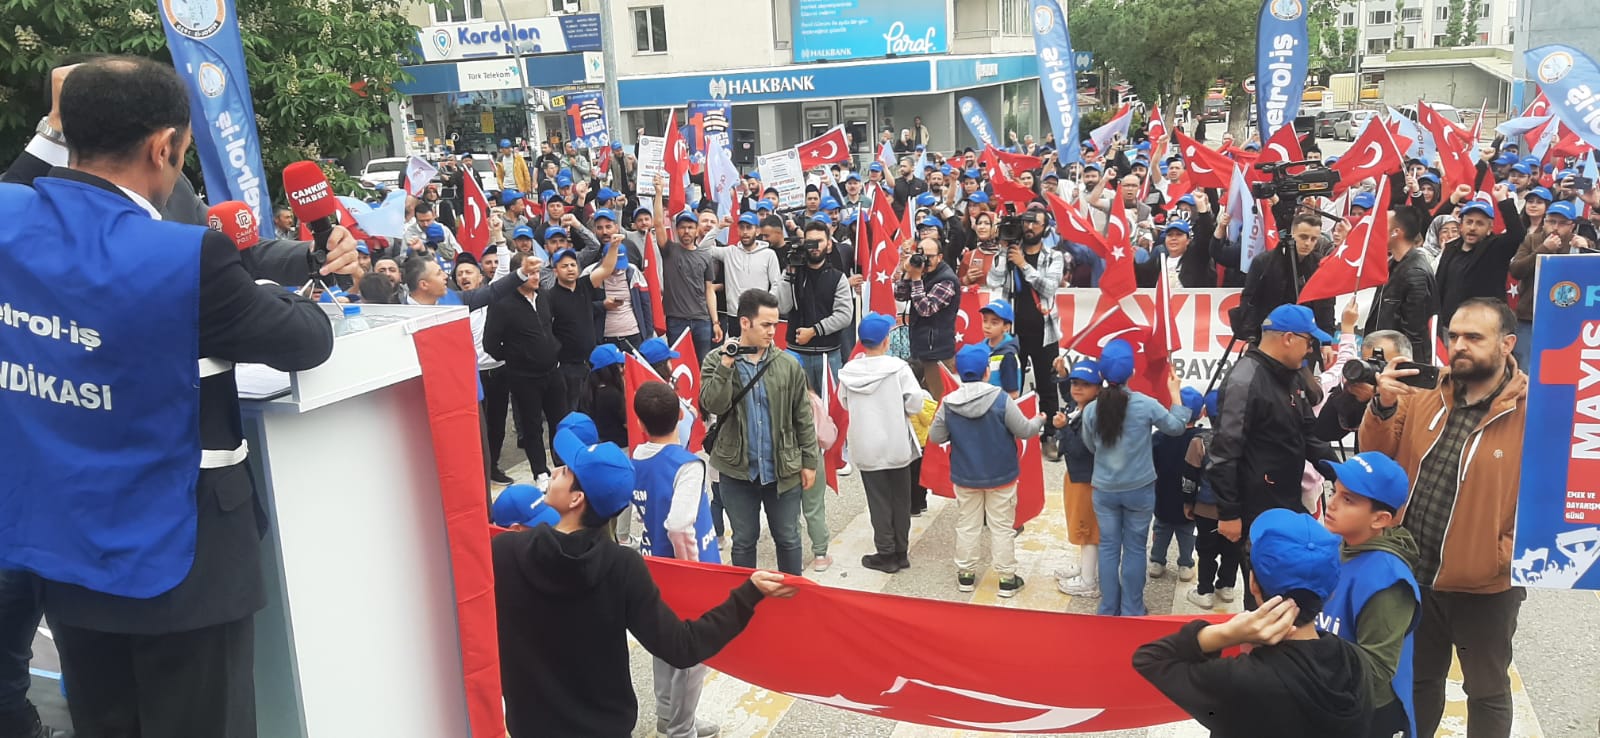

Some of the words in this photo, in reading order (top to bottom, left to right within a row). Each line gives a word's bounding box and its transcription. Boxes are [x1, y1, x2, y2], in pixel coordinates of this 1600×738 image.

[810, 47, 852, 57] HALKBANK
[483, 71, 511, 79] Telekom
[728, 75, 815, 95] HALKBANK
[298, 189, 328, 206] HABER
[0, 302, 102, 352] trol-iş
[1586, 492, 1596, 500] VE
